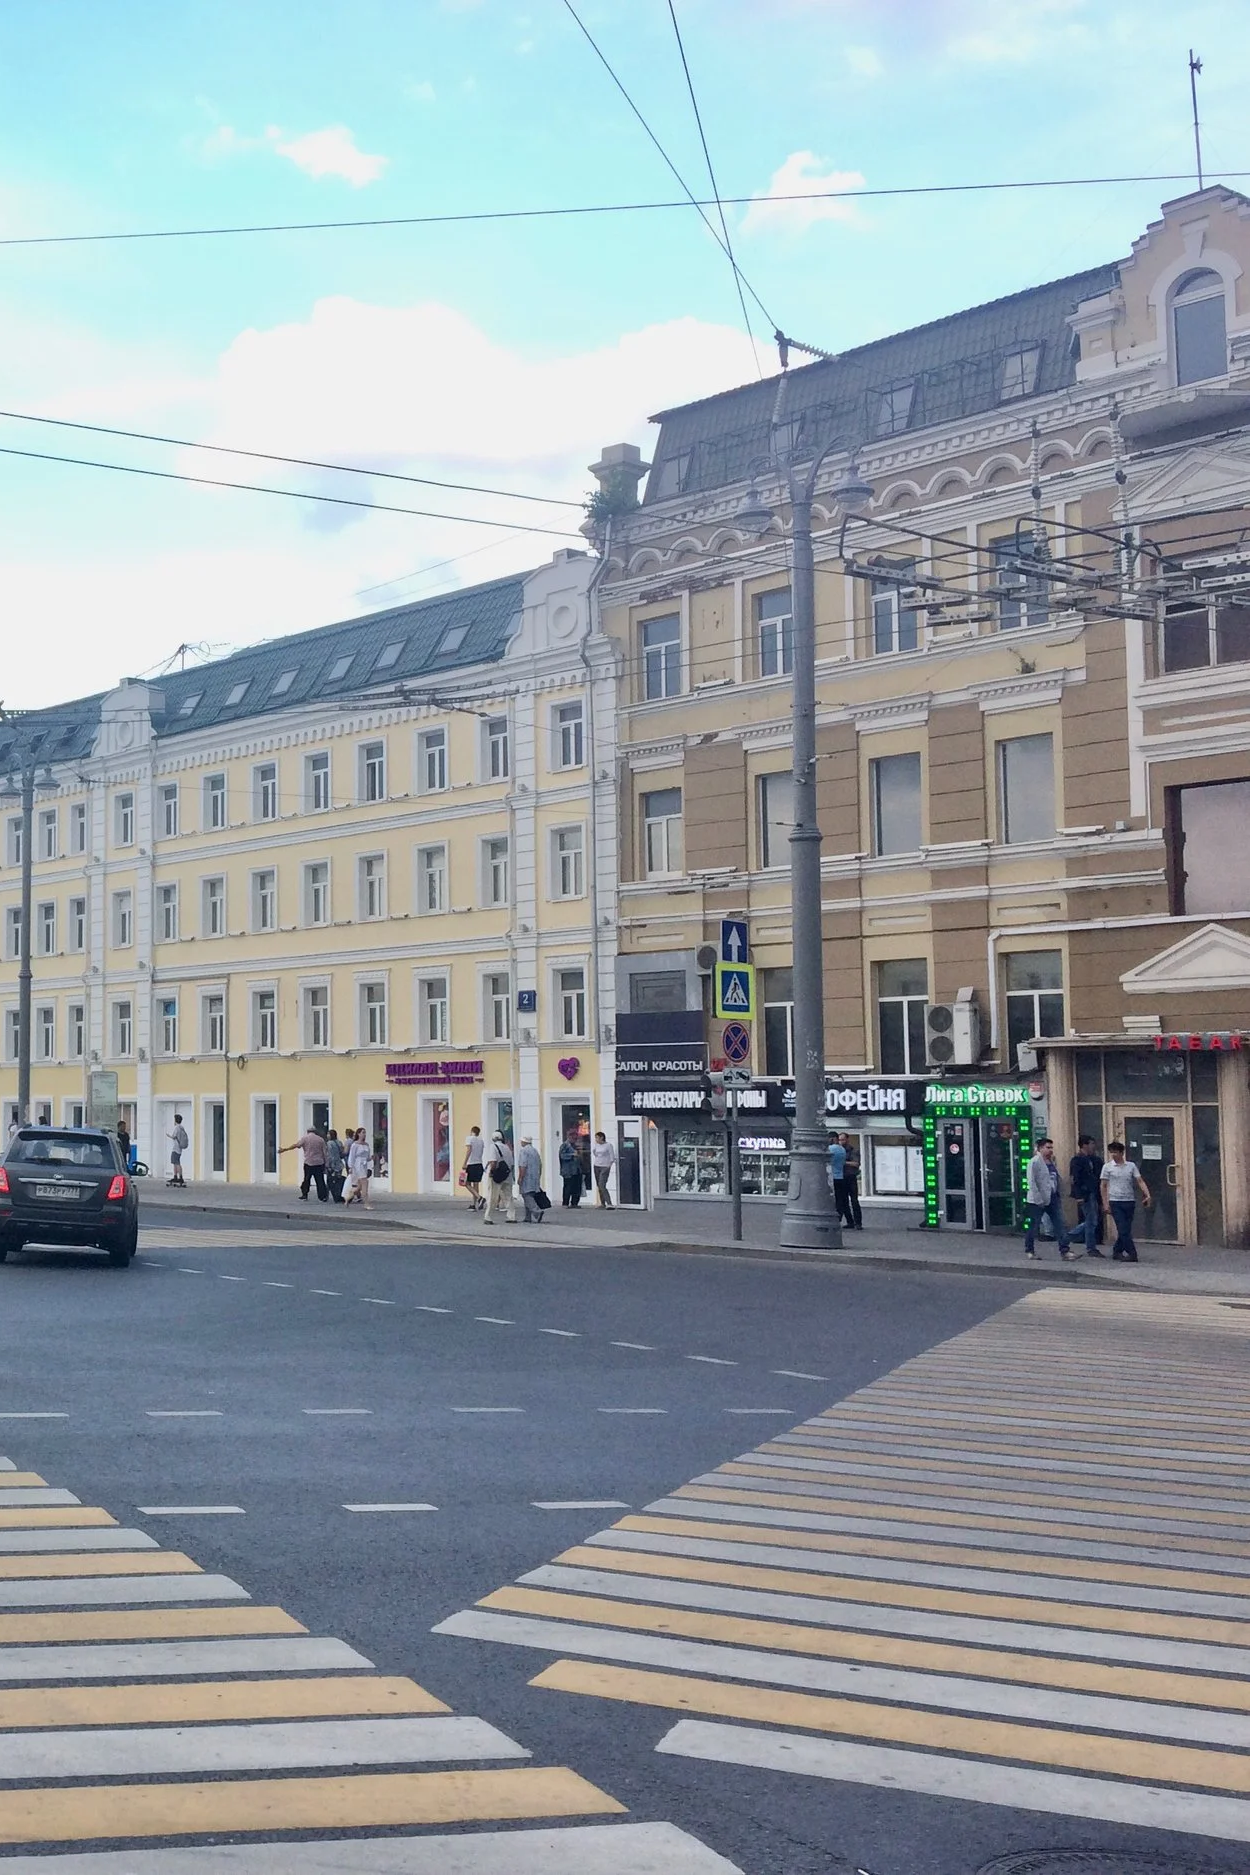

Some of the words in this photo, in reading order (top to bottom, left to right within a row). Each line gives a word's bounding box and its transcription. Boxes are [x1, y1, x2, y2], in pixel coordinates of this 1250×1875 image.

[523, 993, 529, 1004] 2
[615, 1060, 648, 1071] САЛОН
[652, 1060, 703, 1071] КРАСОТЫ
[825, 1084, 906, 1111] ОФЕЙНЯ
[924, 1086, 964, 1102] Лига
[967, 1086, 1024, 1102] Ставок
